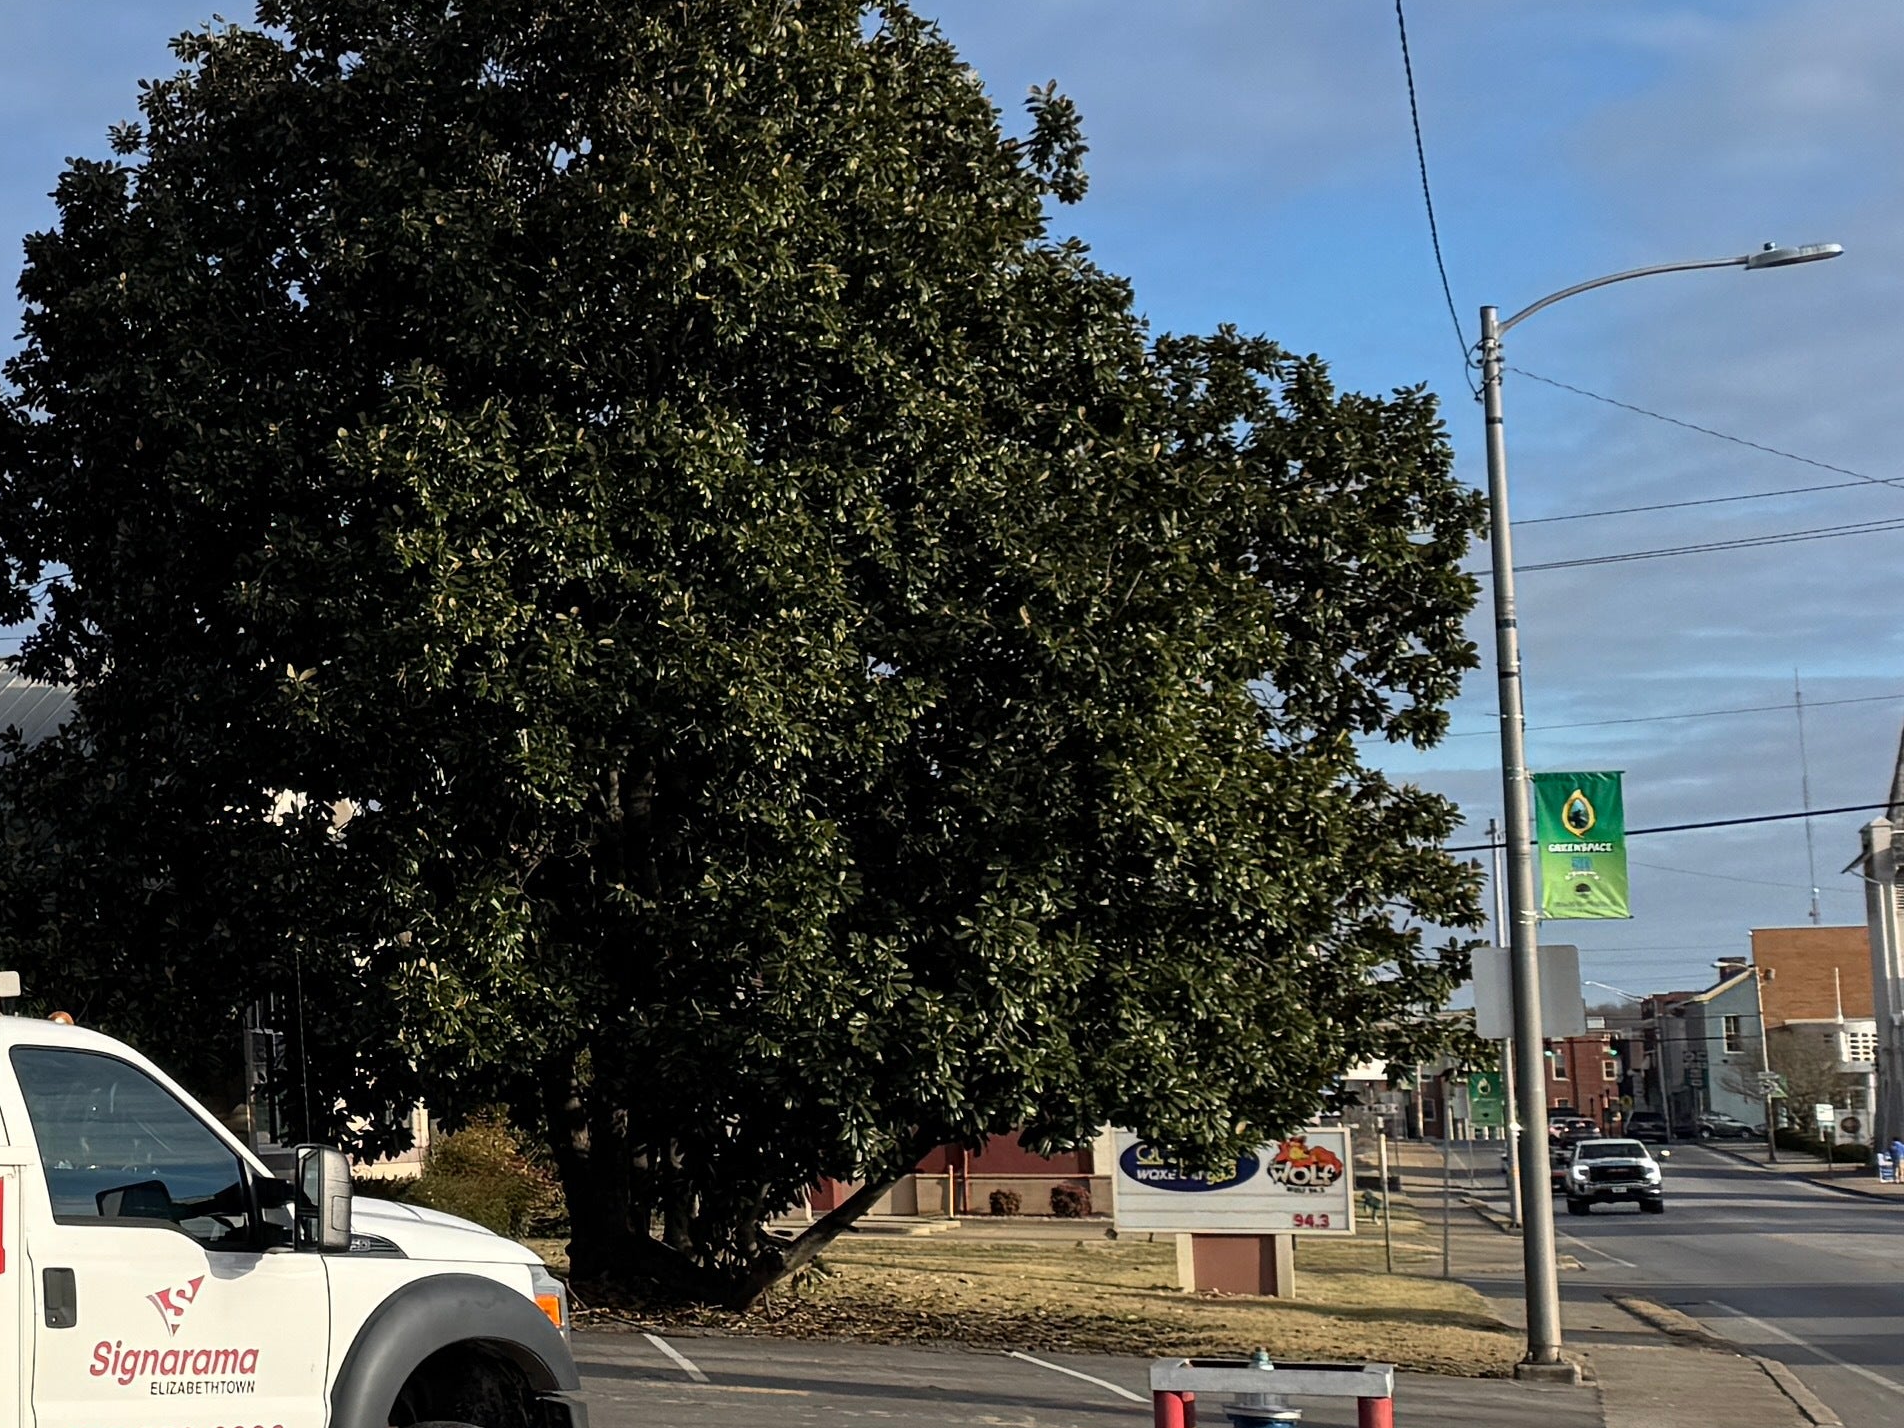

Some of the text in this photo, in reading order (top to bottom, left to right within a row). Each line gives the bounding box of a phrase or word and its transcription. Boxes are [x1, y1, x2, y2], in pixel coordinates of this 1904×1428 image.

[1547, 842, 1613, 853] GREENSPACE
[1293, 1213, 1330, 1228] 94.3
[89, 1340, 260, 1386] Signarama
[150, 1380, 256, 1396] ELIZABETHTOWN
